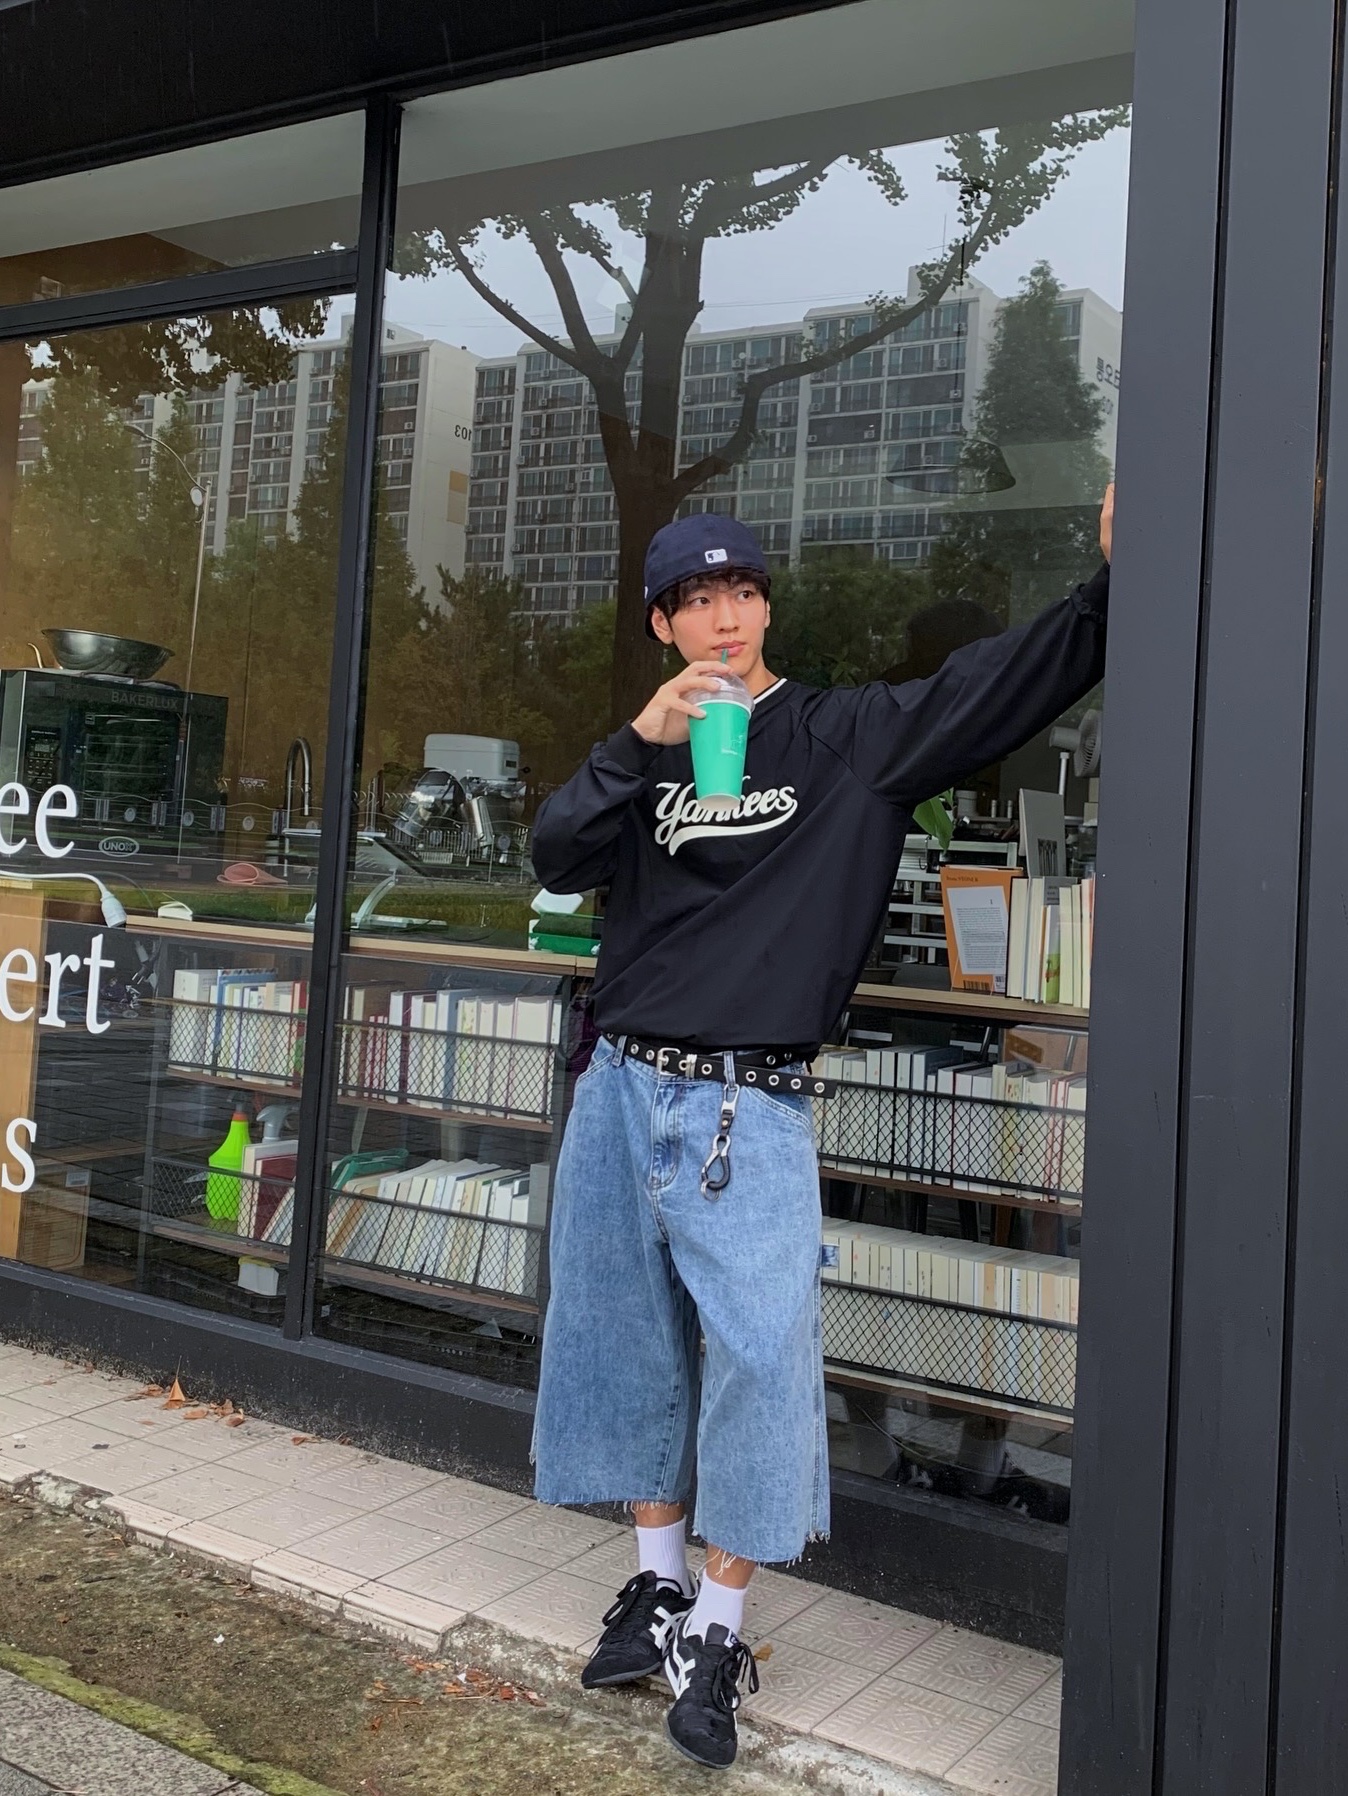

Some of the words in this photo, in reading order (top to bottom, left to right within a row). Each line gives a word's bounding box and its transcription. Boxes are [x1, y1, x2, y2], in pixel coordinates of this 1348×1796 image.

[111, 690, 178, 710] BAKERLUX
[0, 782, 78, 858] ee
[0, 933, 116, 1034] ert
